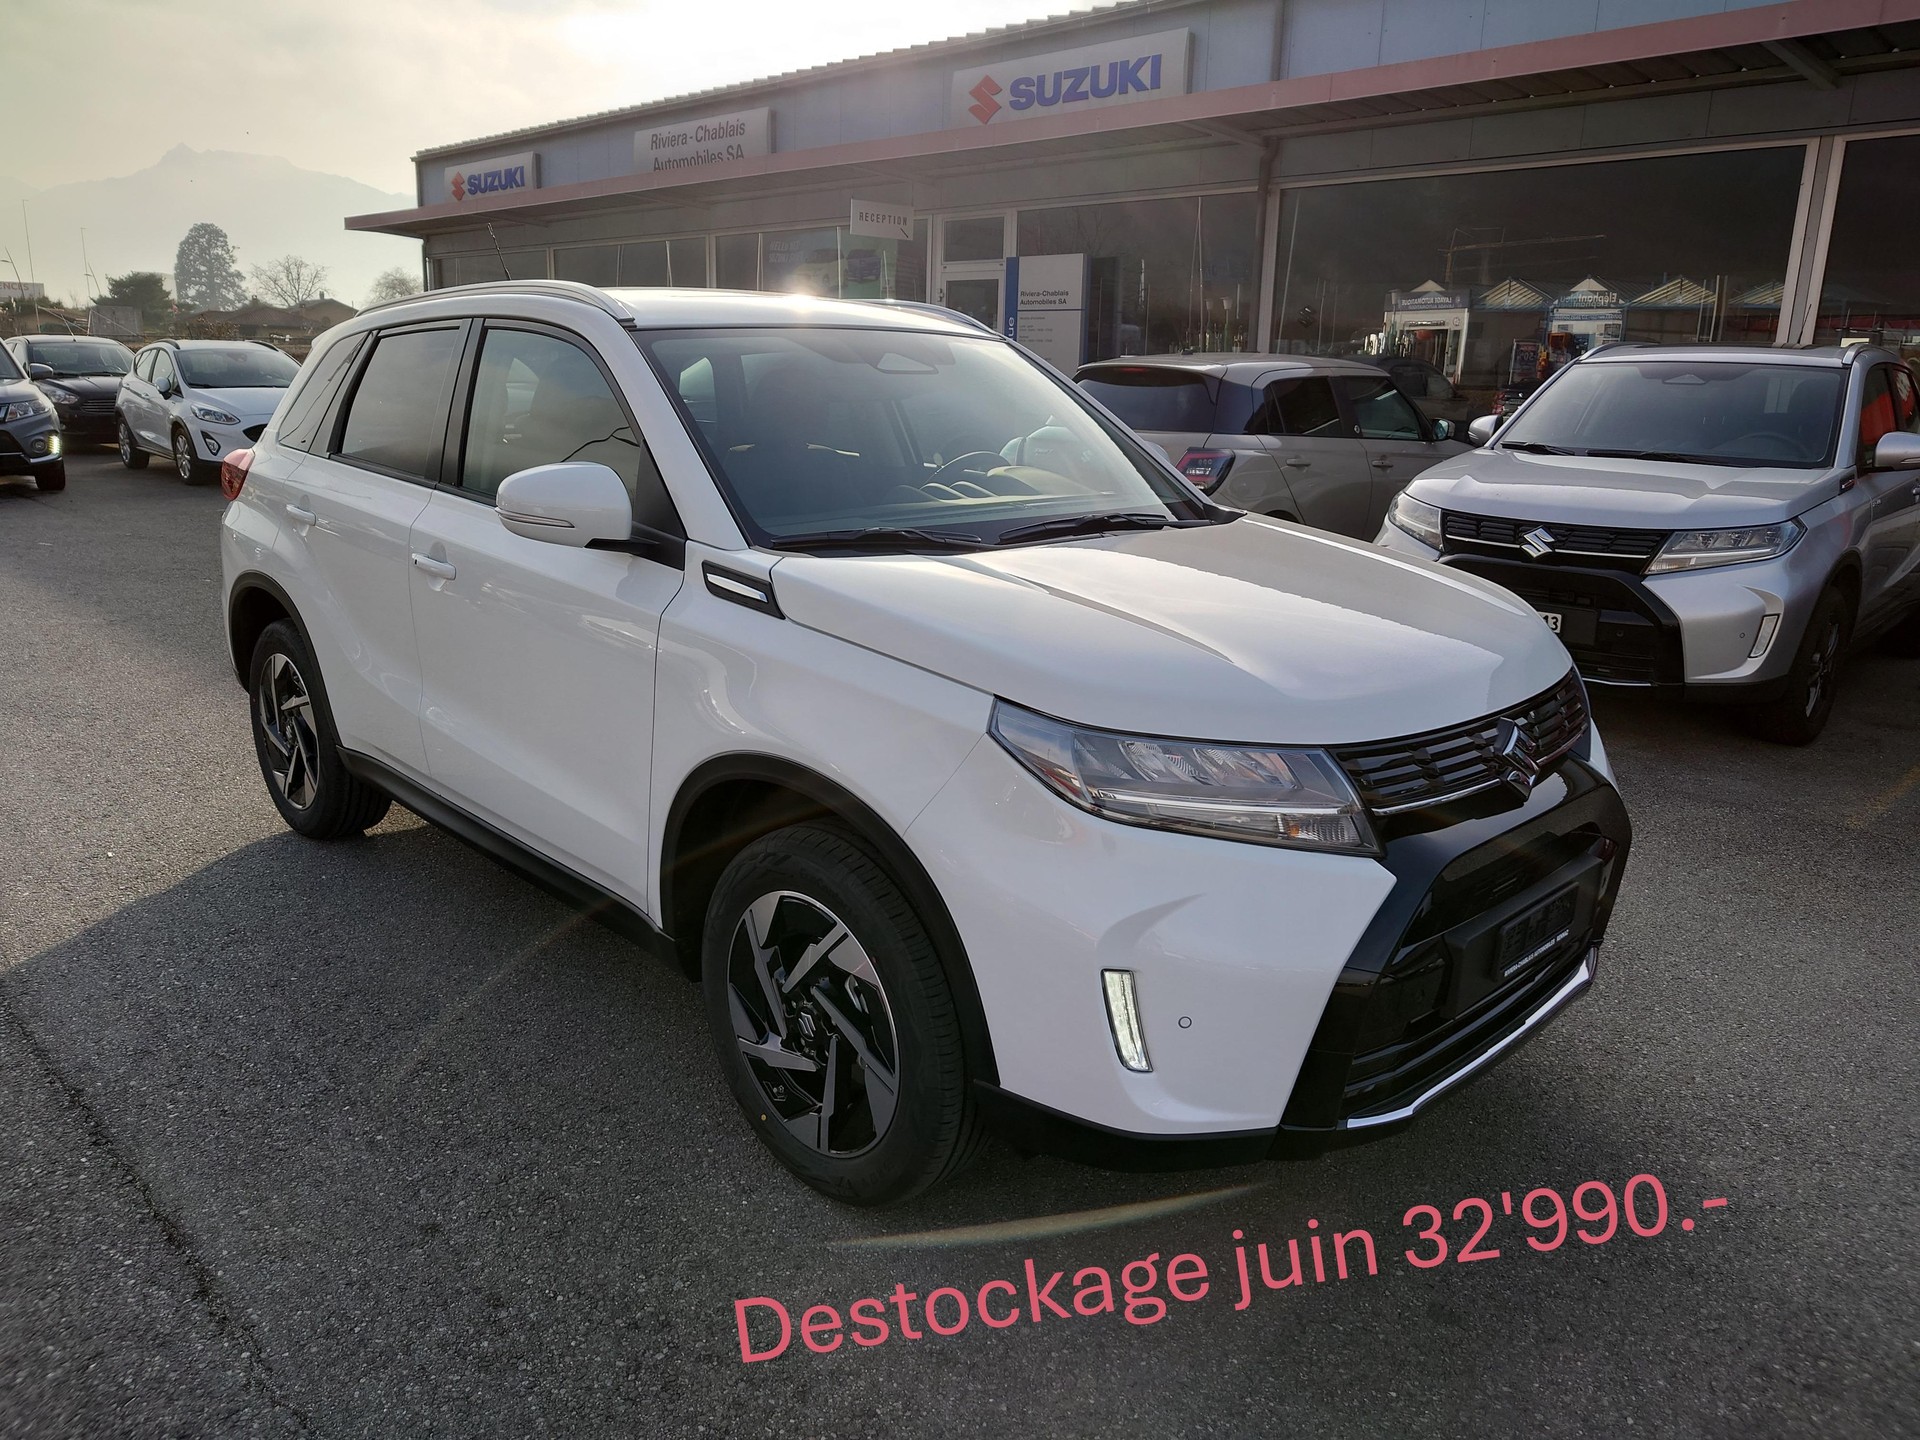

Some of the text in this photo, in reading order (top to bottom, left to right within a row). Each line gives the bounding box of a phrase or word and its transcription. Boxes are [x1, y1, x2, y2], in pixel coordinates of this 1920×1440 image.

[1009, 54, 1162, 110] SUZUKI
[653, 143, 744, 172] Automobiles SA
[467, 166, 525, 195] SUZUKI
[859, 211, 908, 226] RECEPTION
[1020, 290, 1069, 298] Riviera-Chablais
[1020, 298, 1056, 306] Automobiles
